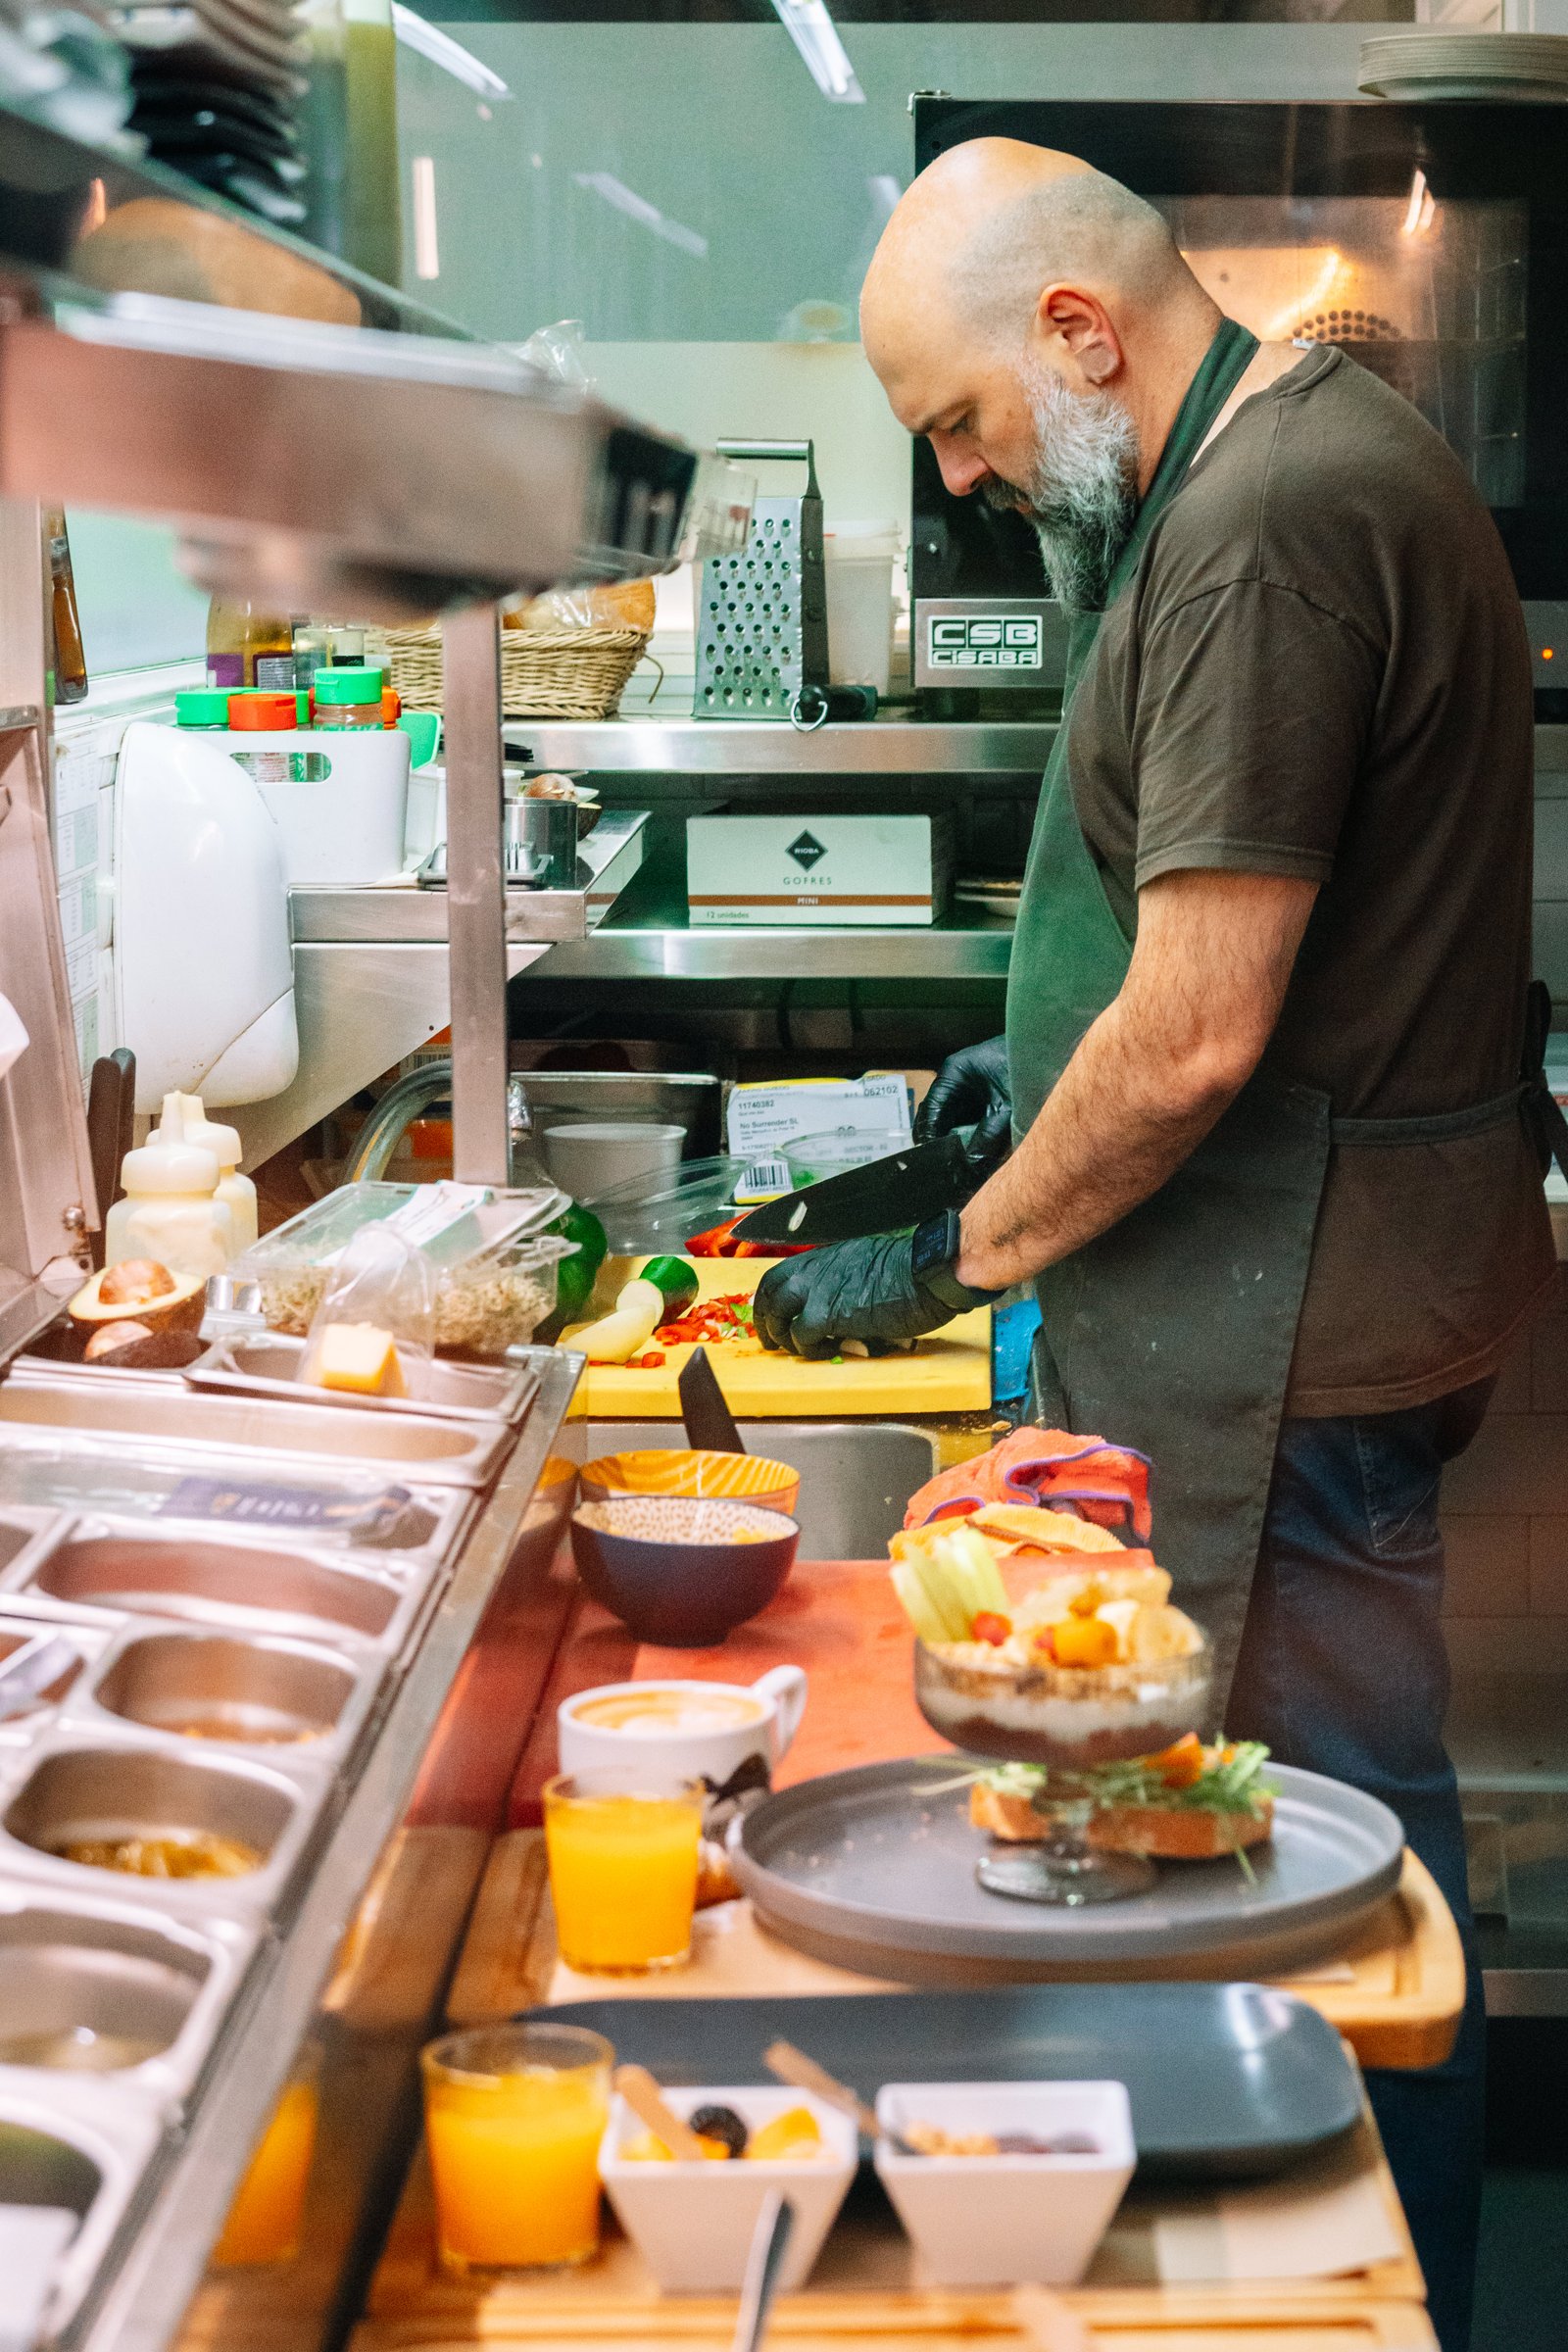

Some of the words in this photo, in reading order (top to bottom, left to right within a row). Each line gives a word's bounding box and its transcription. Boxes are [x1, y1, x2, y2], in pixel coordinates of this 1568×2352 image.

[934, 623, 1037, 645] CSB
[783, 876, 832, 886] GOFRES
[797, 897, 819, 906] MINI
[706, 910, 715, 919] 12
[717, 909, 750, 919] unidades
[863, 1085, 898, 1097] 062102
[738, 1099, 775, 1109] 11740382
[752, 1119, 788, 1128] Surrender
